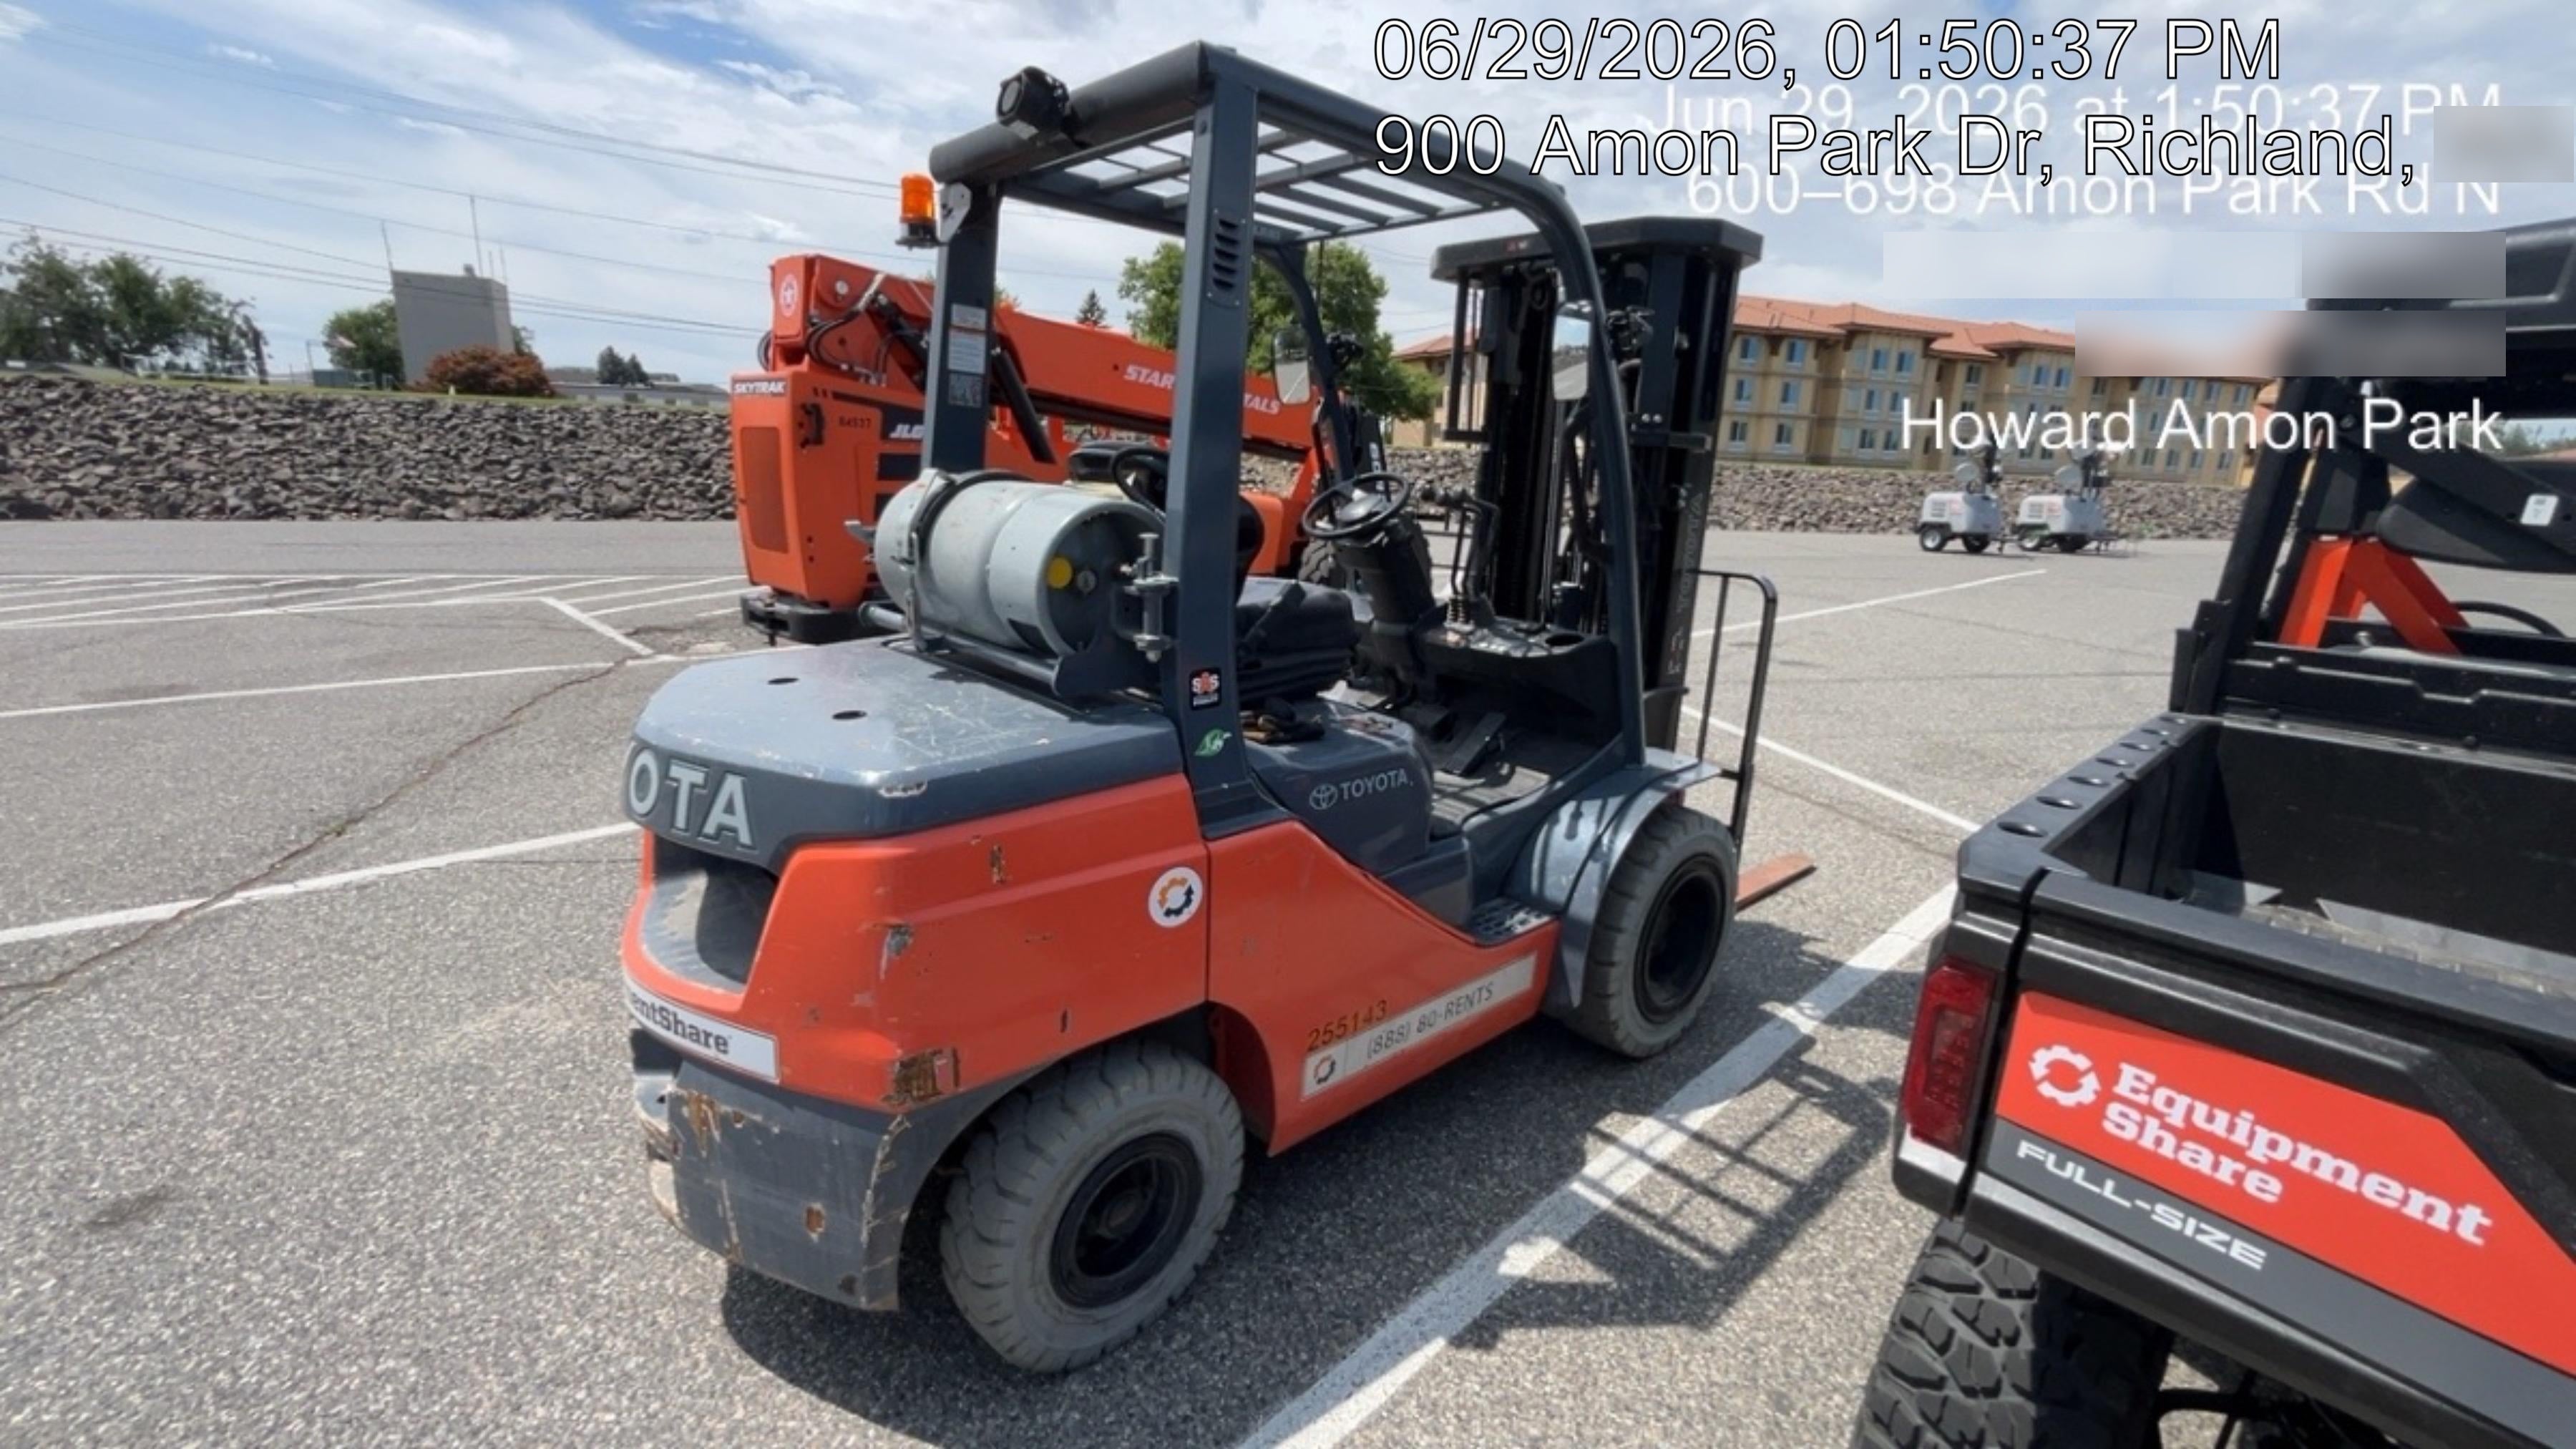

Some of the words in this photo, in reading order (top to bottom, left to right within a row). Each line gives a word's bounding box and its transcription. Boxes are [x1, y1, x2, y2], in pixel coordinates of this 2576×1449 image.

[733, 381, 786, 394] SKYTRAK
[1243, 393, 1281, 415] TALS
[629, 748, 753, 847] OTA
[1339, 768, 1408, 801] TOYOTA
[633, 993, 729, 1055] entShare
[1307, 999, 1388, 1053] 255143
[1415, 981, 1494, 1035] 80-RENTS
[2102, 1102, 2284, 1204] Share
[2111, 1061, 2493, 1247] Equipment
[2016, 1138, 2268, 1272] FULL-SIZE
